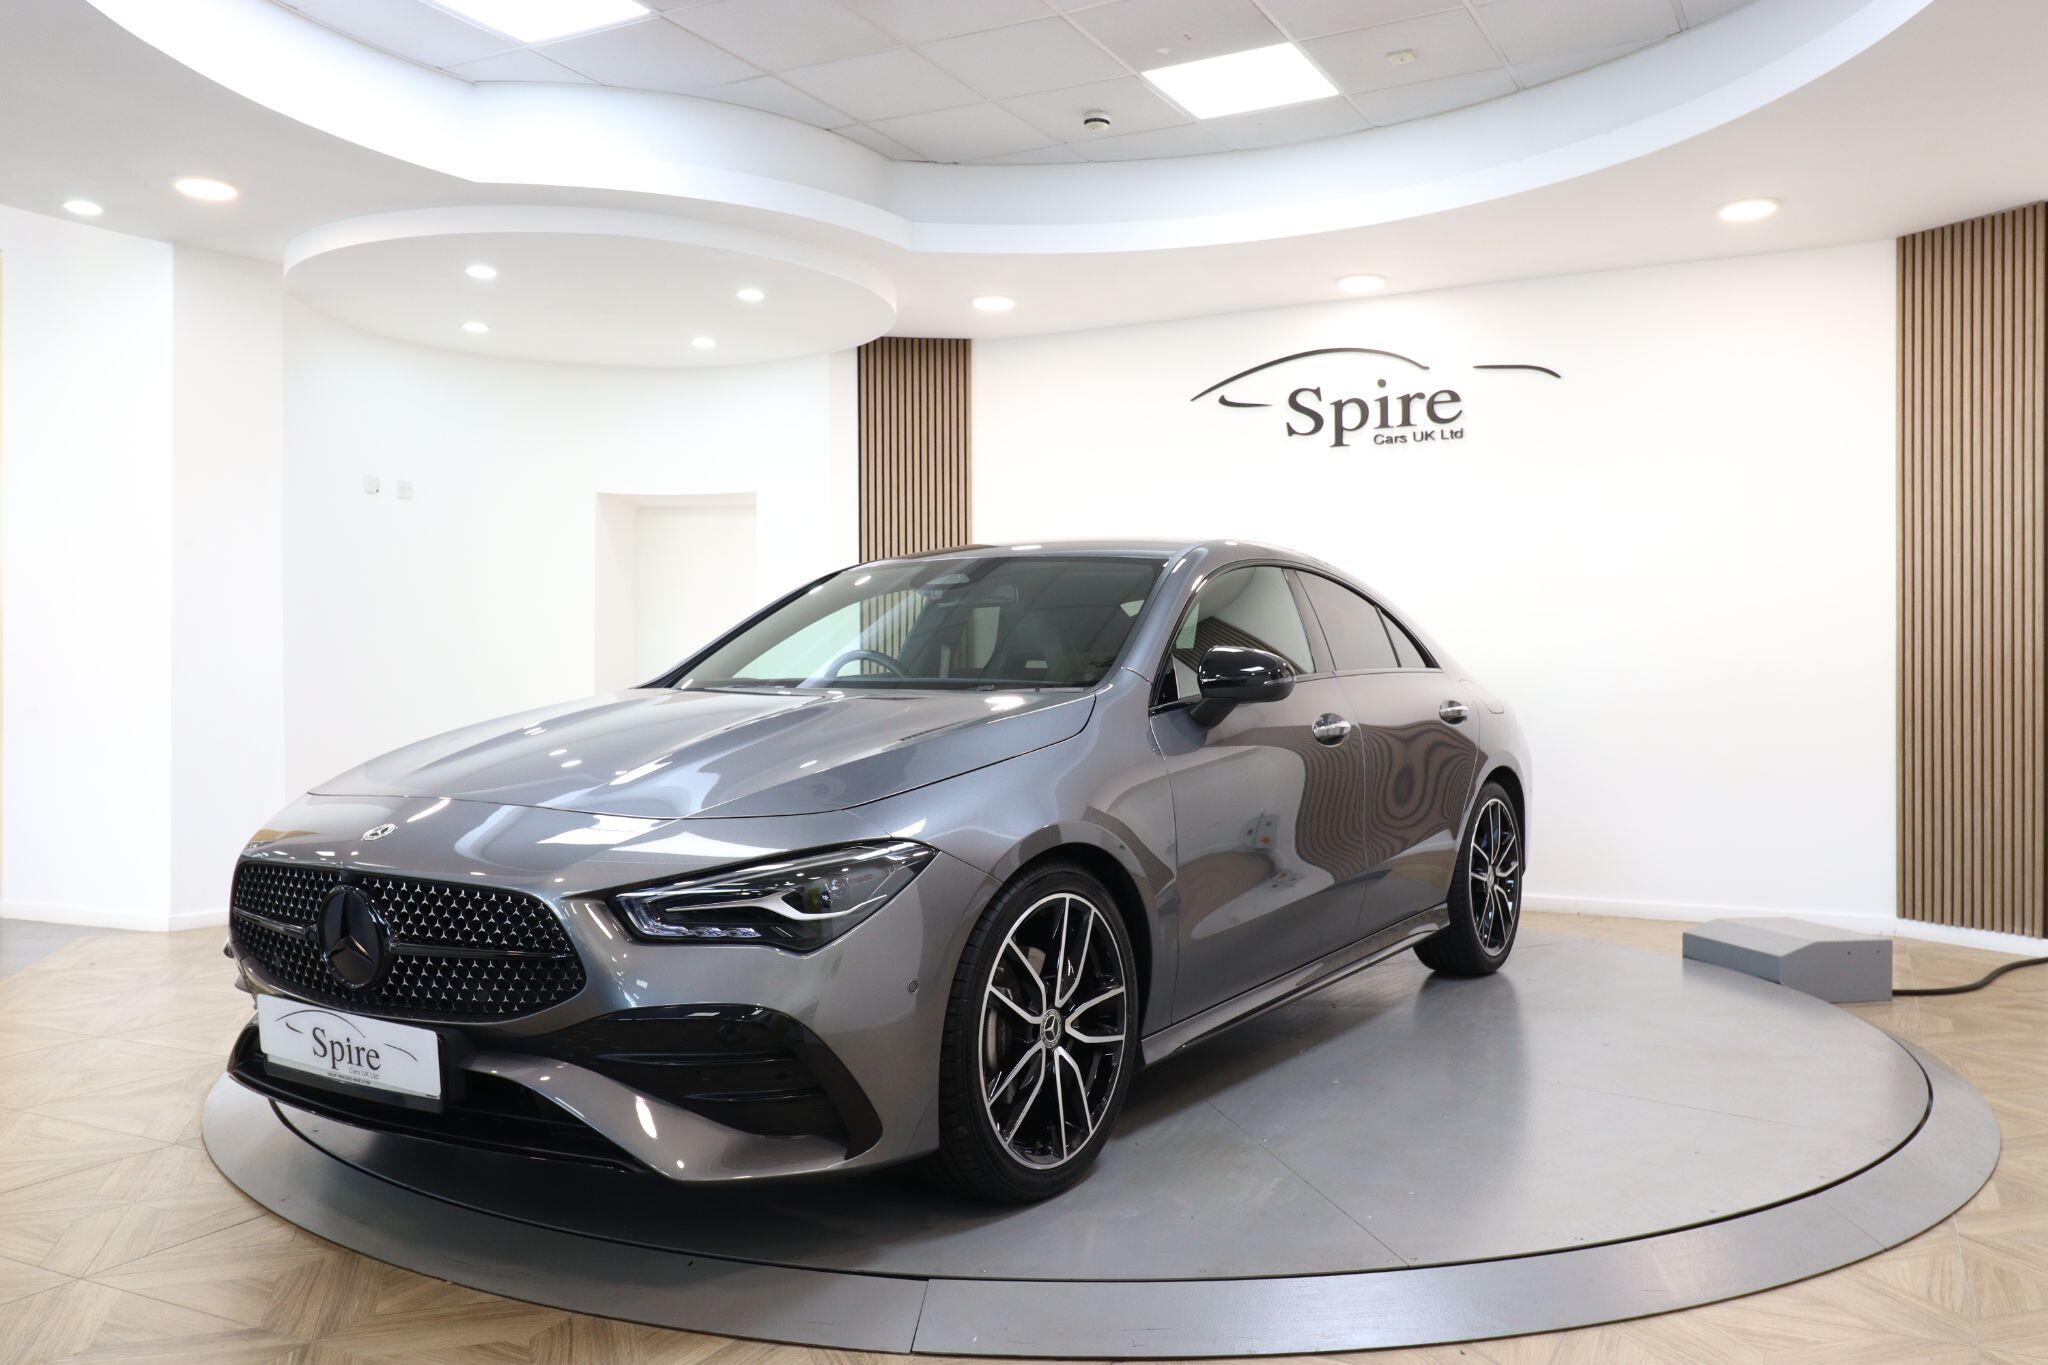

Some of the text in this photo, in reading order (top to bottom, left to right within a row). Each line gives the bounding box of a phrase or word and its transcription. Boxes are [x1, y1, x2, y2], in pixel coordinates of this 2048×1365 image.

[1286, 378, 1463, 448] Spire
[1373, 428, 1464, 446] Cars UK Ltd
[312, 1027, 381, 1070] Spire
[348, 1067, 361, 1076] Cars
[361, 1069, 370, 1078] UK
[370, 1072, 379, 1080] Ltd
